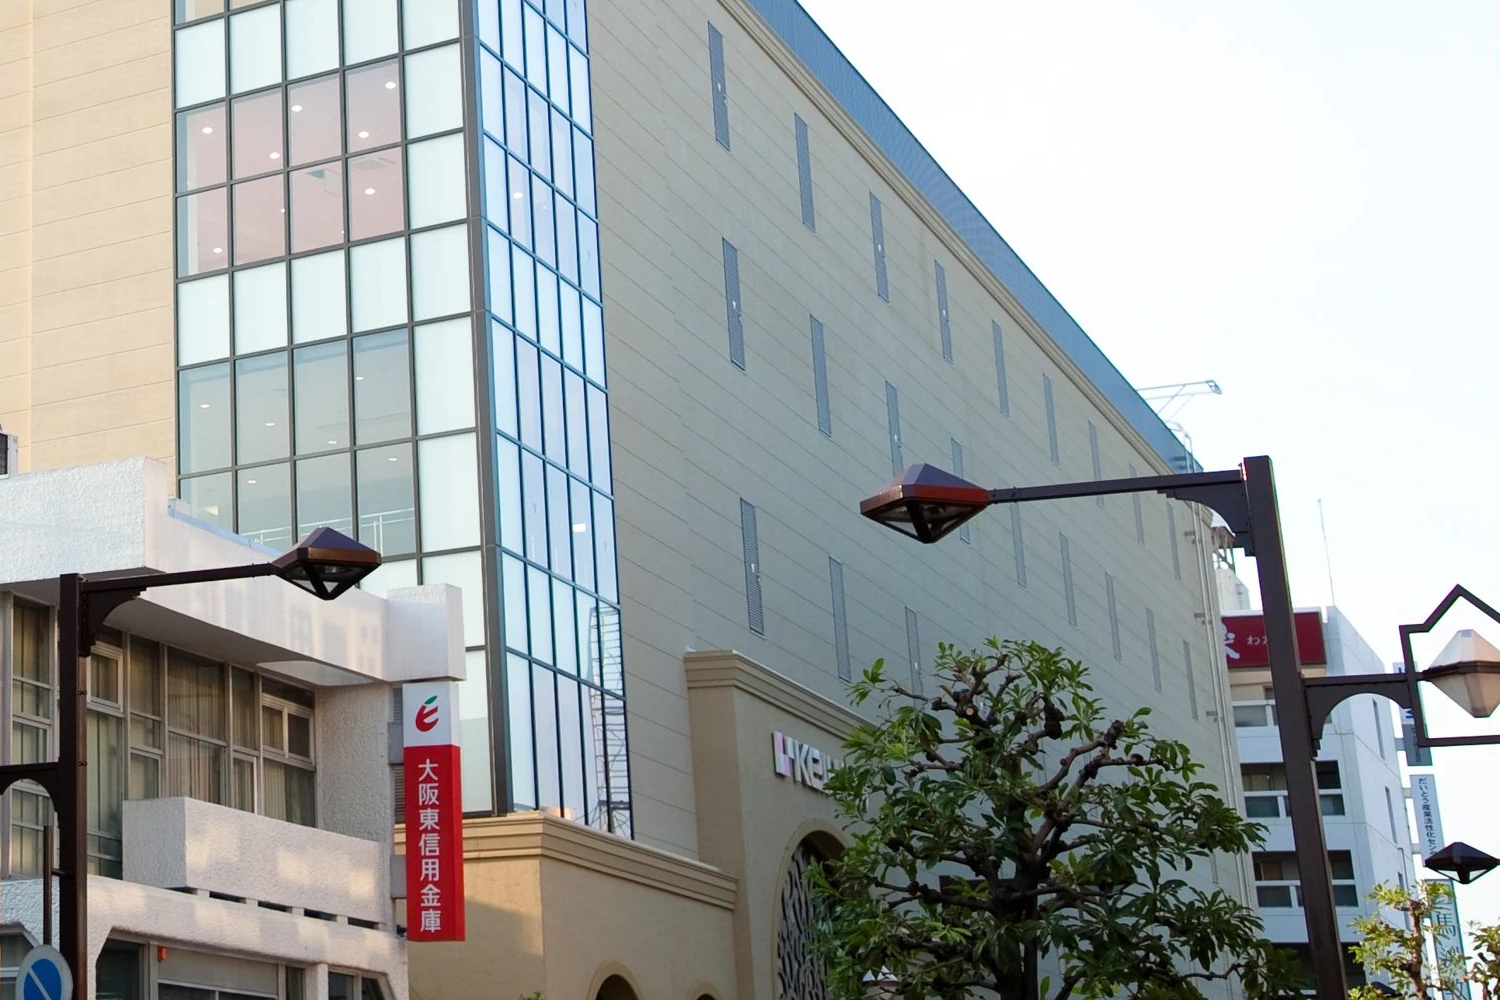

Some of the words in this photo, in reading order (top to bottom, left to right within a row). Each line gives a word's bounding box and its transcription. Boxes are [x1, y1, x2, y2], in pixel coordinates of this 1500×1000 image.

[417, 757, 443, 934] 大阪東信用金庫
